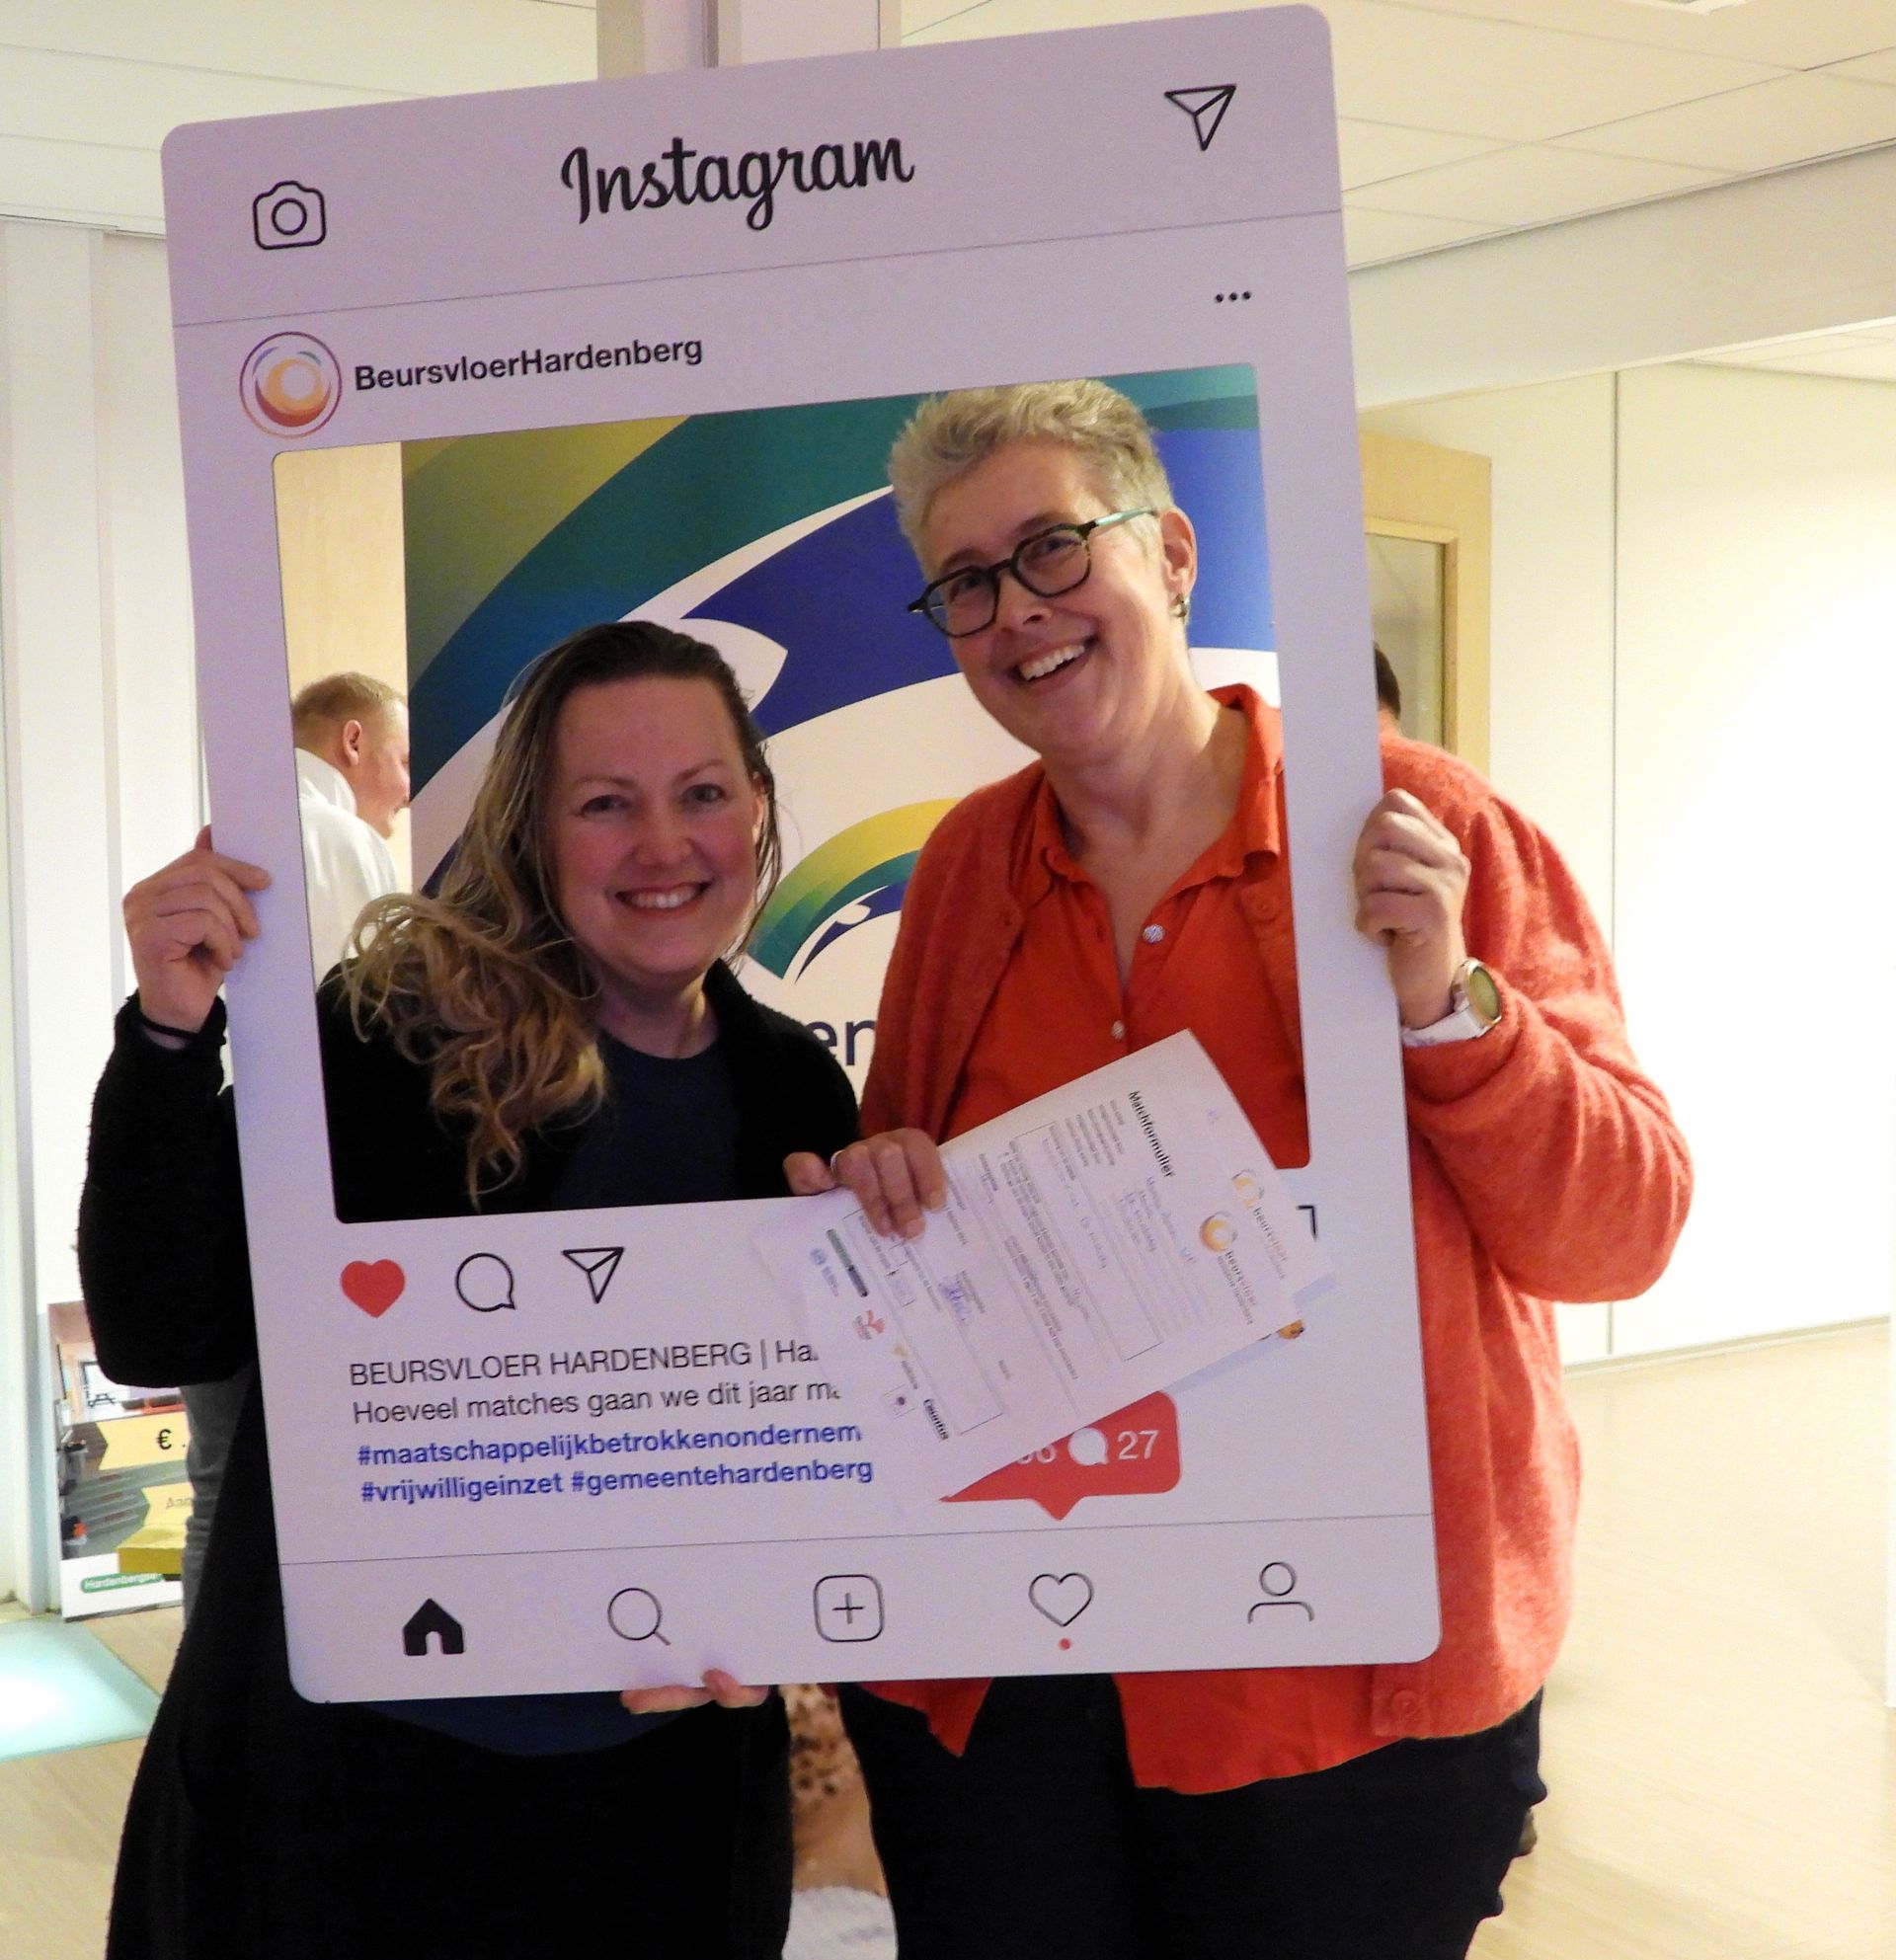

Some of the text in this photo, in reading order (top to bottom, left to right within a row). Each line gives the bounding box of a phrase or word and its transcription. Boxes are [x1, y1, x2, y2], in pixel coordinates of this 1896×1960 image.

[560, 136, 915, 231] Instagram
[355, 339, 703, 392] BeursvloerHardenberg
[349, 1353, 541, 1385] BEURSVLOER
[549, 1341, 751, 1374] HARDENBERG
[775, 1339, 820, 1364] Ha
[353, 1395, 458, 1424] Hoeveel
[466, 1391, 580, 1418] matches
[587, 1387, 653, 1417] gaan
[659, 1388, 700, 1408] we
[707, 1382, 742, 1406] dit
[748, 1379, 798, 1409] jaar
[356, 1423, 862, 1466] #maatschappelijkbetrokkenondernem
[1117, 1430, 1160, 1460] 27
[361, 1459, 874, 1505] #vrijwilligeinzet #gemeentehardenberg
